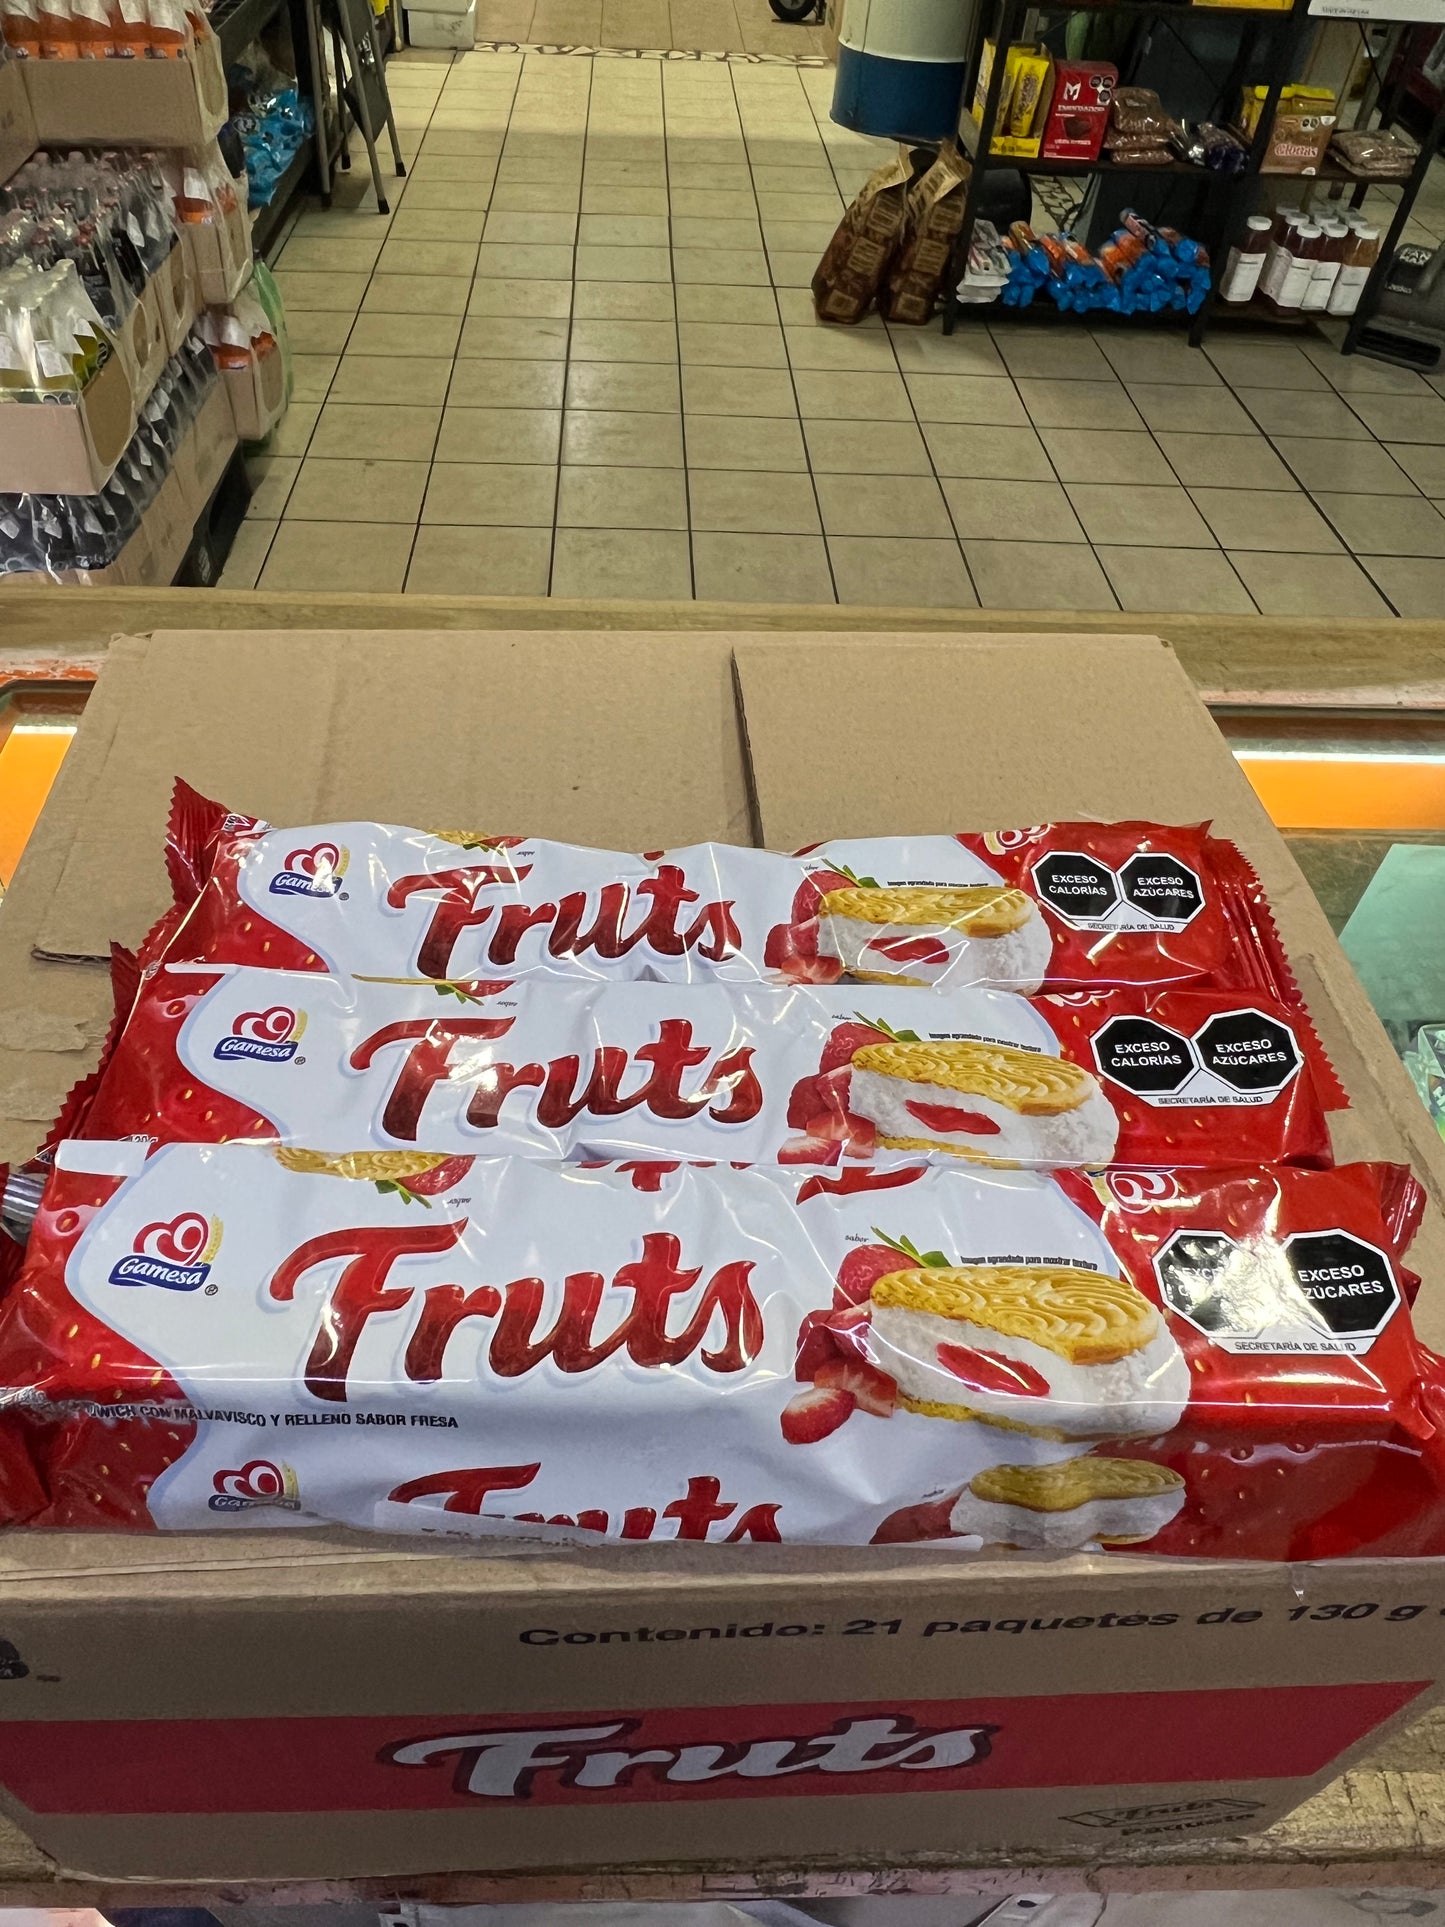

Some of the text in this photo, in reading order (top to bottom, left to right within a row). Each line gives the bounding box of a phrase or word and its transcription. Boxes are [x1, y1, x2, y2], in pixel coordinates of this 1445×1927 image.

[1052, 875, 1098, 884] EXCESO
[1137, 877, 1184, 886] EXCESO
[1049, 885, 1108, 896] CALORÍAS
[1133, 887, 1194, 899] AZÚCARES
[387, 863, 742, 979] Fruts
[221, 1038, 291, 1057] Gamesa
[1115, 1041, 1170, 1054] EXCESO
[1216, 1039, 1272, 1053] EXCESO
[1111, 1054, 1182, 1067] CALORÍAS
[1212, 1052, 1287, 1066] AZÚCARES
[349, 1016, 763, 1142] Fruts
[1158, 1096, 1216, 1104] SECRETARÍA
[1232, 1096, 1263, 1104] SALUD
[845, 1233, 869, 1242] sabor
[119, 1258, 202, 1285] Gamesa
[1298, 1264, 1364, 1282] EXCESO
[1303, 1280, 1384, 1299] ZÚCARES
[269, 1216, 764, 1402] Fruts
[1235, 1341, 1301, 1351] SECRETARÍA
[1305, 1341, 1319, 1351] DE
[140, 1406, 171, 1418] CON
[174, 1408, 266, 1427] MALVAVISCO
[270, 1414, 281, 1426] Y
[285, 1413, 351, 1426] RELLENO
[356, 1413, 406, 1426] SABOR
[411, 1415, 459, 1428] FRESA
[519, 1622, 825, 1646] Contenido:
[842, 1619, 903, 1635] 21
[923, 1608, 1180, 1637] paquetes
[1196, 1607, 1263, 1625] de
[1288, 1603, 1379, 1622] 130
[1384, 1604, 1428, 1622] g
[385, 1714, 992, 1798] Fruts
